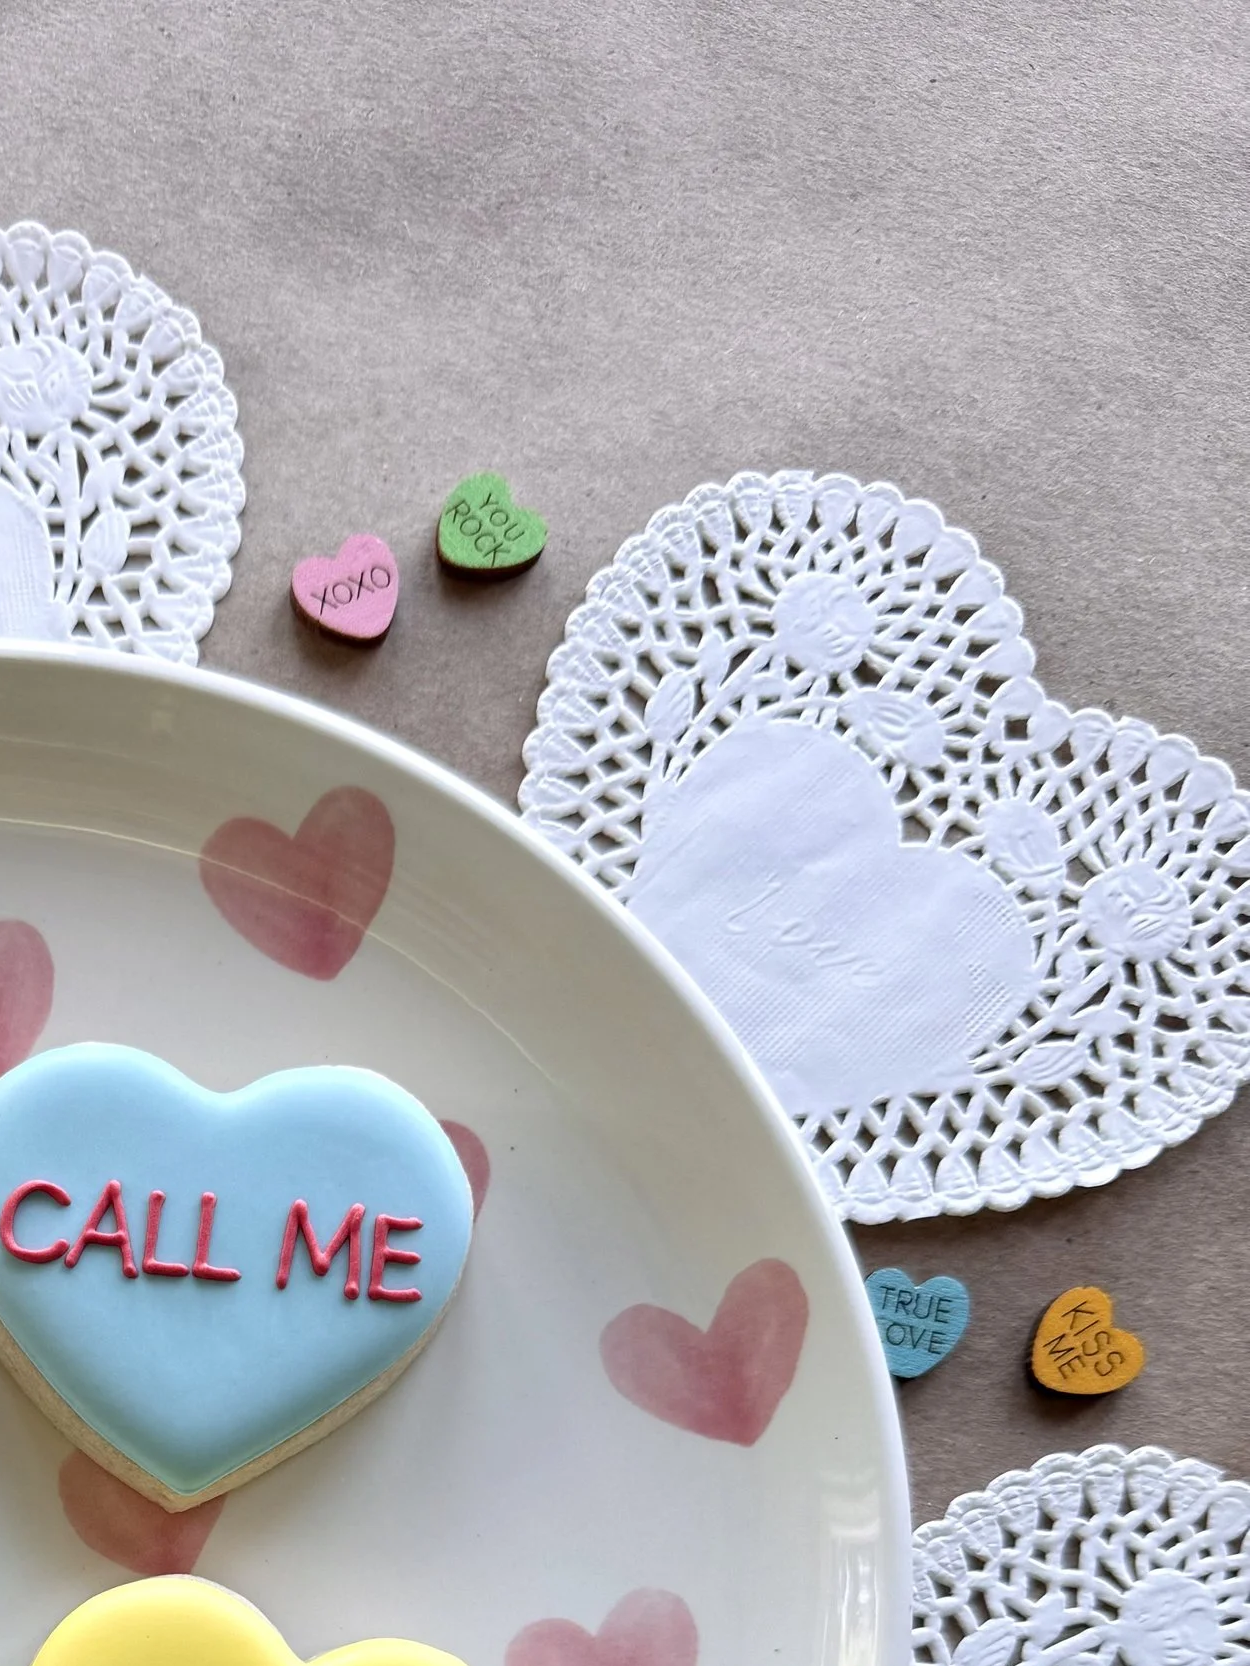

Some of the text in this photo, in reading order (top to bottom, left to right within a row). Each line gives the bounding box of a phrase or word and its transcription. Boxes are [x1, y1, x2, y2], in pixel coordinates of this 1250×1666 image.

[446, 499, 510, 566] ROCK
[480, 492, 525, 542] YOU
[311, 566, 391, 616] XOXO
[0, 1179, 424, 1302] CALL ME
[880, 1286, 953, 1324] TRUE
[883, 1321, 947, 1355] OVE
[1043, 1333, 1087, 1380] ME
[1061, 1301, 1126, 1378] KISS
